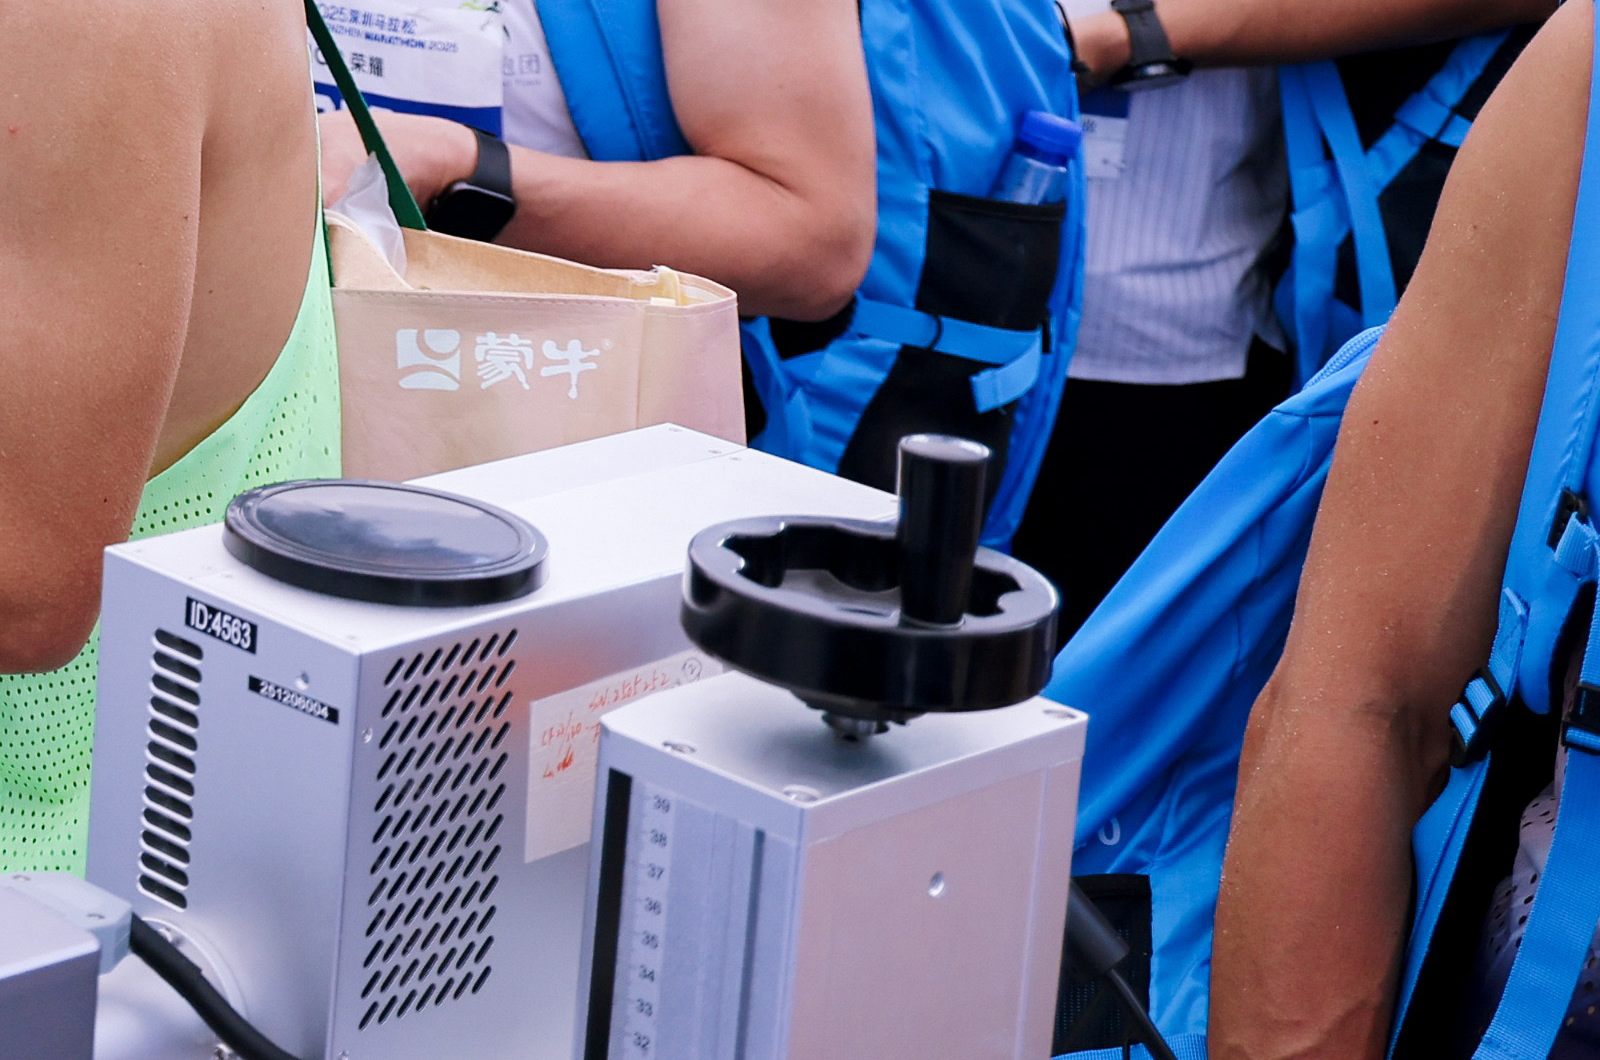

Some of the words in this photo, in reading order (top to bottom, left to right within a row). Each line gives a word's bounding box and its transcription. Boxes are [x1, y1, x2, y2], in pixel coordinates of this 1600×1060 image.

[319, 3, 417, 36] 025深圳马拉松
[474, 331, 601, 399] 蒙牛
[190, 601, 252, 649] ID:4563
[653, 794, 671, 813] 39
[650, 828, 668, 848] 38
[647, 863, 665, 881] 37
[644, 896, 662, 915] 36
[642, 930, 659, 949] 35
[638, 965, 655, 982] 34
[636, 998, 653, 1017] 33
[633, 1031, 650, 1052] 32
